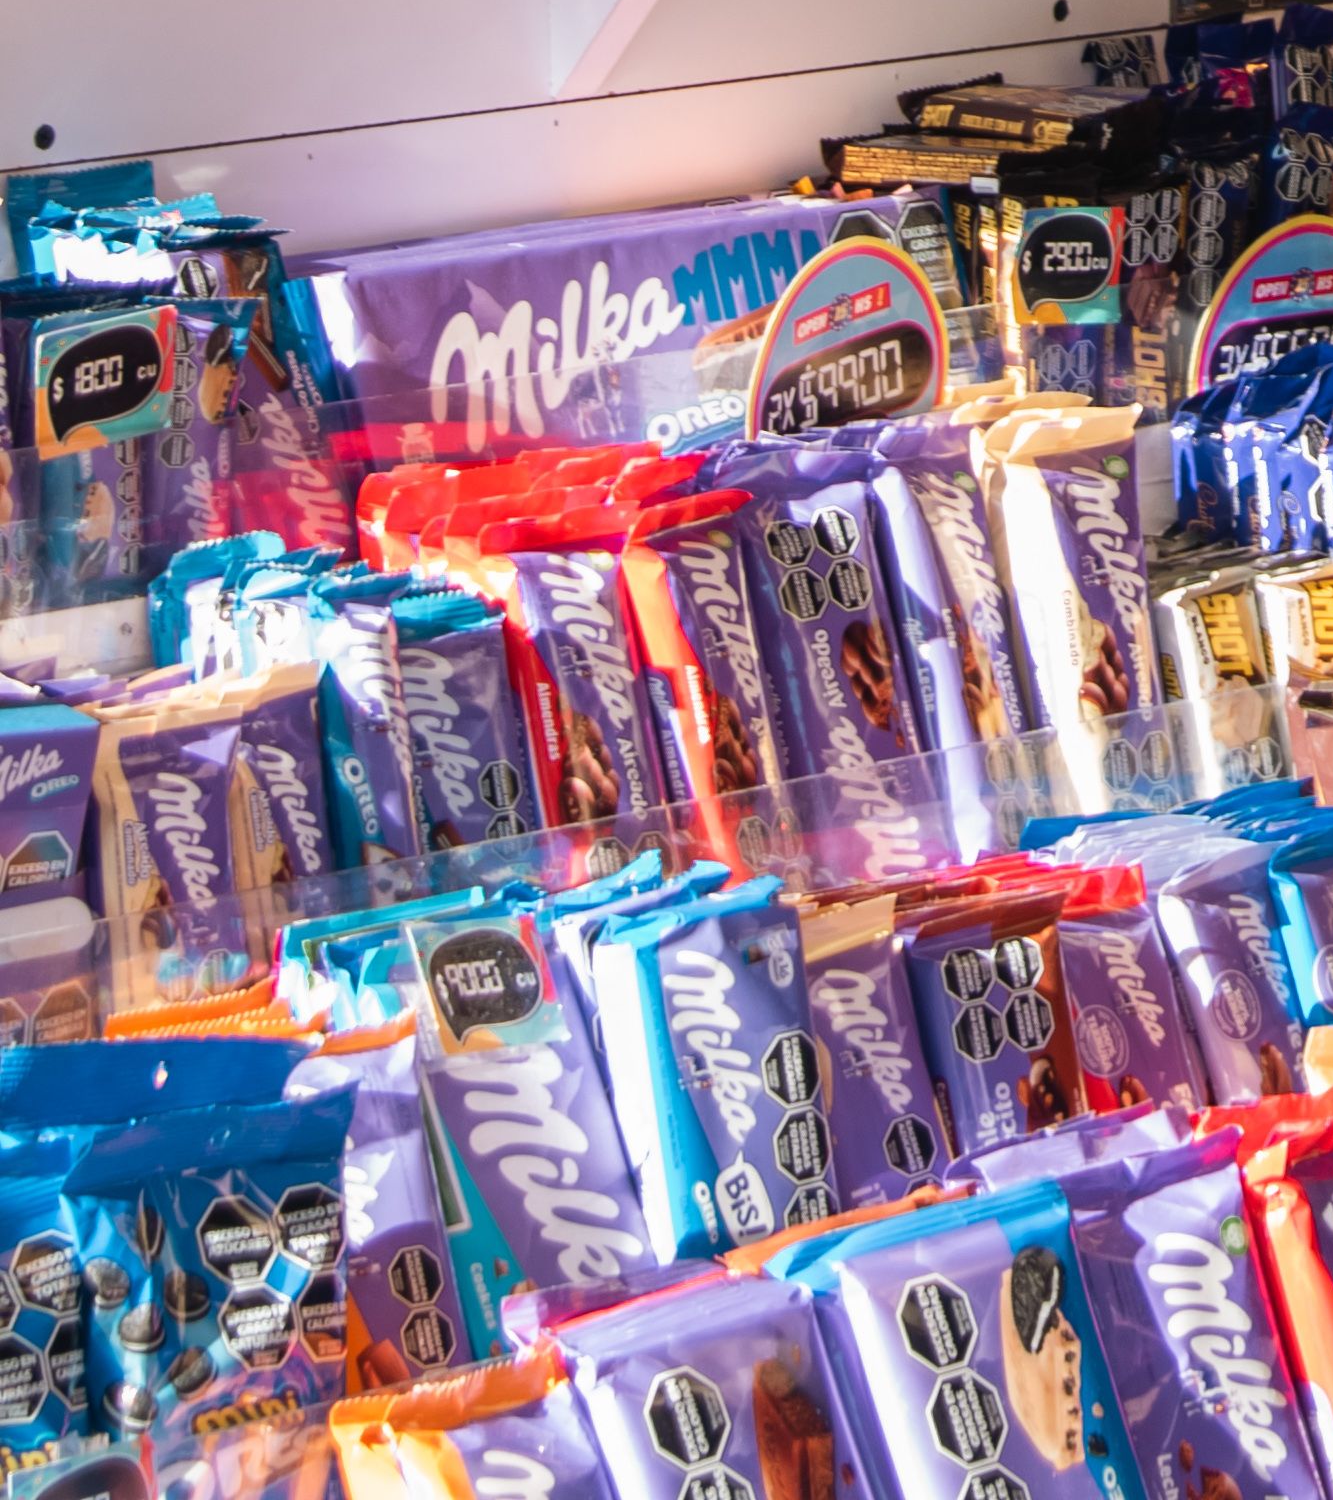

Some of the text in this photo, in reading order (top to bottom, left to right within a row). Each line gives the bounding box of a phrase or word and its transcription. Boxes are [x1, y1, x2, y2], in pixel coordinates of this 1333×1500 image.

[796, 312, 829, 340] OPEN
[1255, 281, 1288, 302] OPEN
[74, 352, 158, 396] 1800 CU
[429, 259, 686, 456] Milka
[647, 392, 748, 450] OREO
[257, 392, 351, 562] Milka
[928, 472, 1006, 657] Milka
[1069, 465, 1149, 642] Milka
[537, 550, 639, 732] Milka
[683, 534, 766, 714] Milka
[811, 626, 848, 713] Aireado
[1060, 588, 1082, 668] Combinado
[1190, 614, 1211, 667] BLANCO
[1199, 590, 1256, 681] SHOT
[401, 643, 472, 817] Milka
[533, 679, 560, 763] Almendras
[29, 771, 80, 799] OREO
[146, 770, 222, 913] Milka
[256, 742, 321, 876] Milka
[340, 753, 382, 838] OREO
[826, 719, 930, 880] Milka
[1101, 929, 1165, 1049] Milka
[1228, 892, 1291, 1009] Milka
[662, 950, 760, 1148] Milka
[816, 965, 914, 1118] Milka
[1146, 1230, 1292, 1482] Milka
